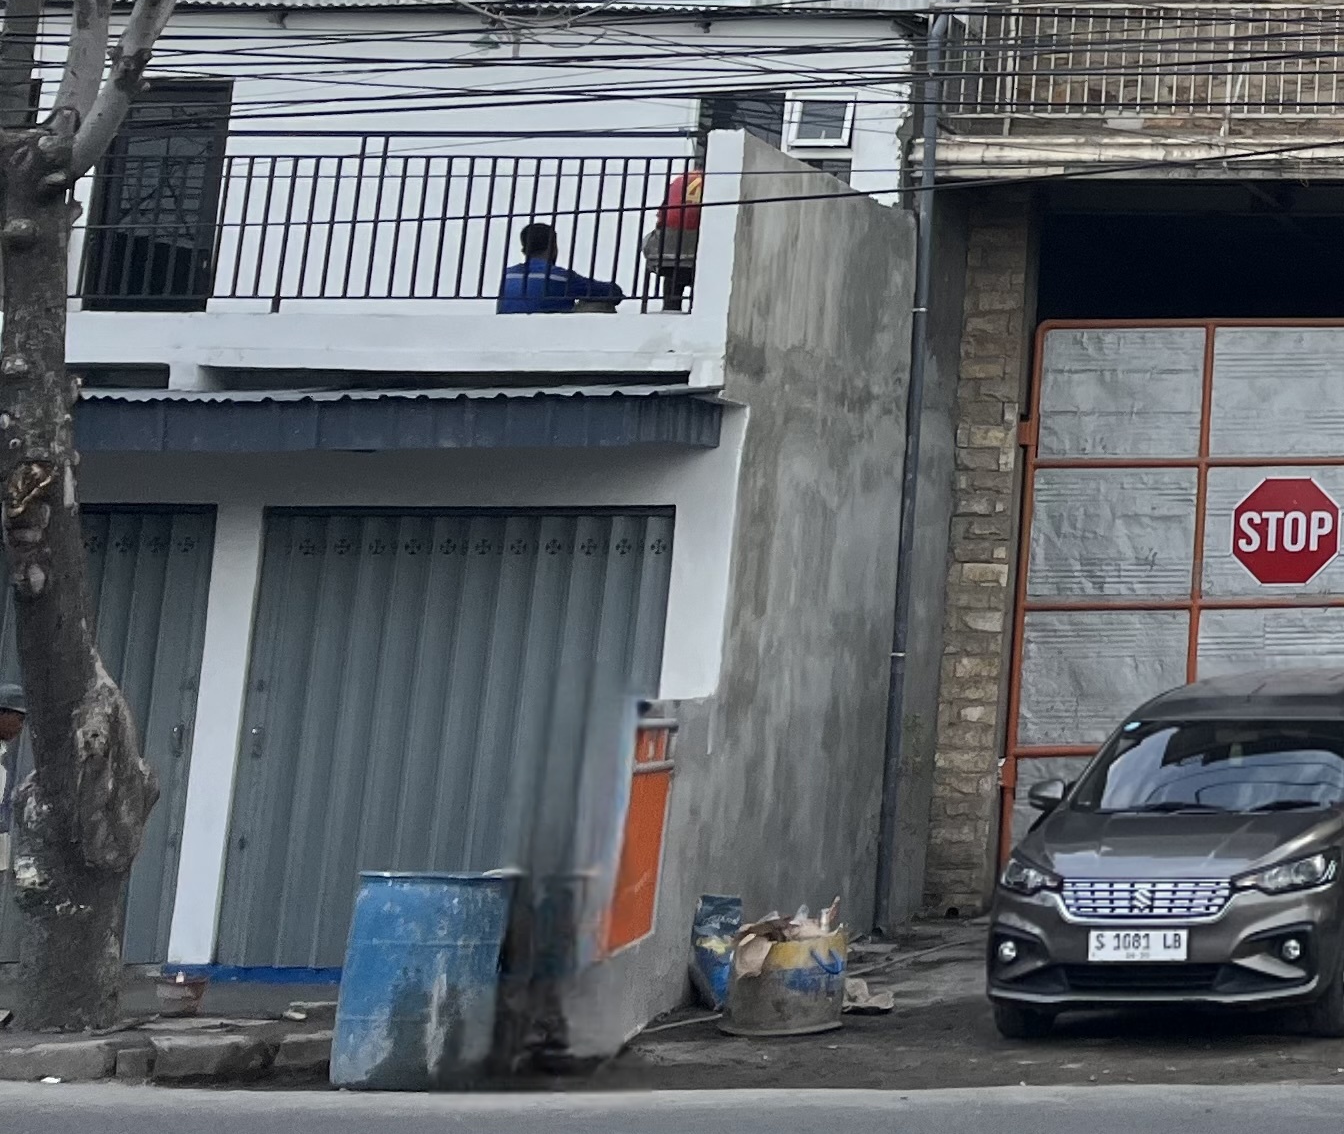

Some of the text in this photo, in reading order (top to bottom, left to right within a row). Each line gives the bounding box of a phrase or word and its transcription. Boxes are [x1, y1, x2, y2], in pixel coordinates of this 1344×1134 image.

[1238, 510, 1333, 552] STOP
[1095, 933, 1105, 950] S
[1163, 933, 1182, 949] LB
